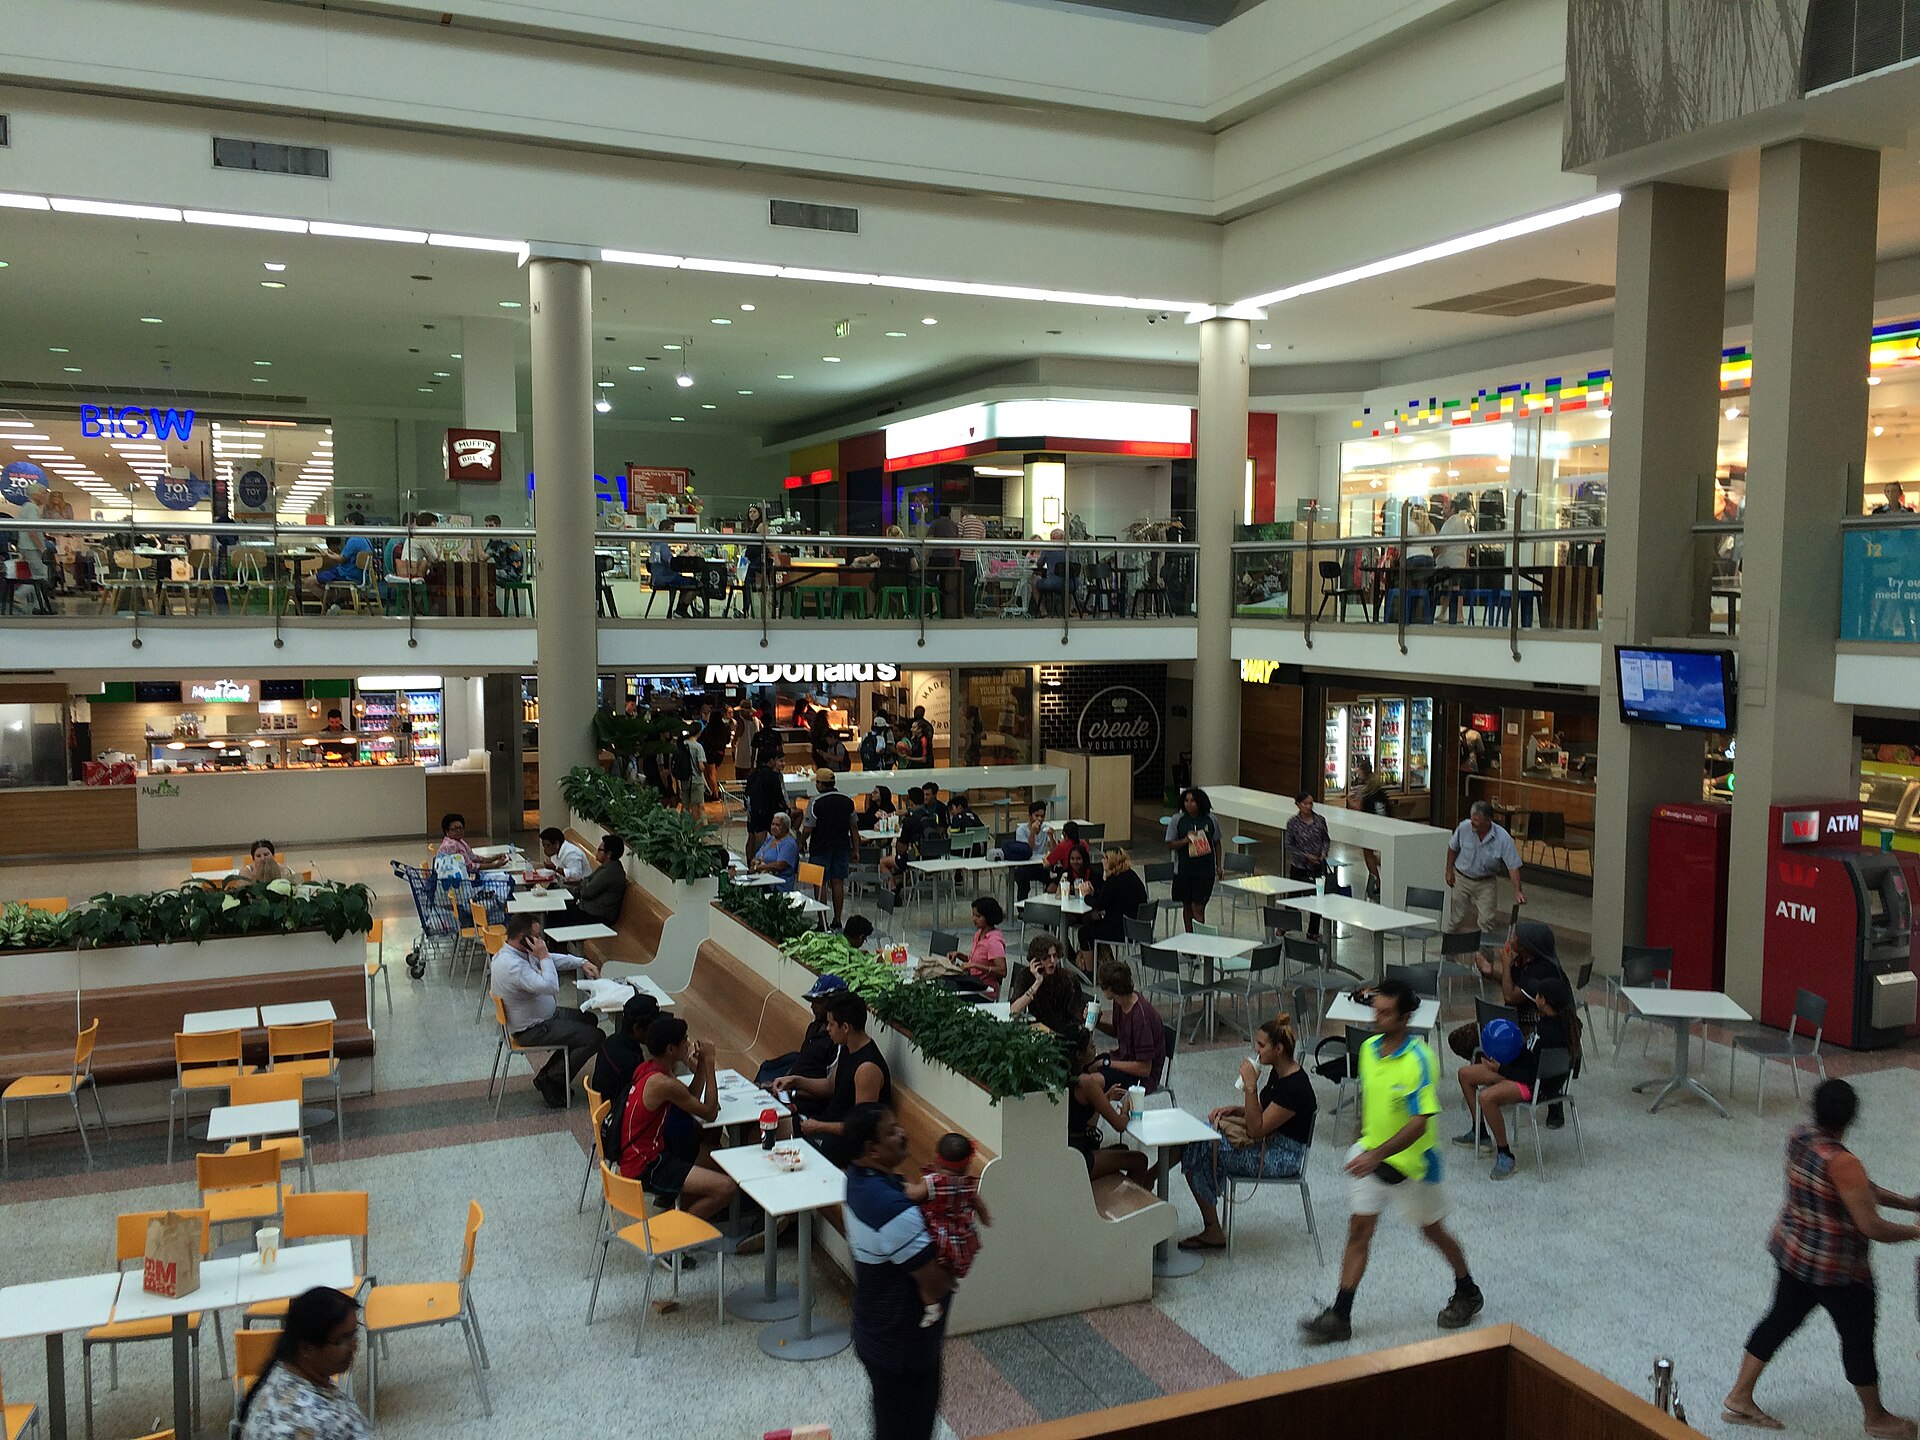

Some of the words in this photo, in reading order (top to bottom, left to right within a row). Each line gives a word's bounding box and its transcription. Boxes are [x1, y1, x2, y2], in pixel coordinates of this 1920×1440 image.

[458, 440, 491, 449] MUFFIN
[7, 487, 29, 498] SAL
[163, 492, 193, 502] SALE
[245, 488, 261, 496] TOY
[1887, 577, 1904, 591] Try
[1875, 588, 1901, 600] meal
[704, 663, 897, 684] McDonalds
[979, 685, 996, 696] YOUR
[1088, 715, 1150, 739] create
[1088, 740, 1115, 750] YOUR
[1826, 814, 1859, 834] ATM
[1775, 900, 1817, 924] ATM
